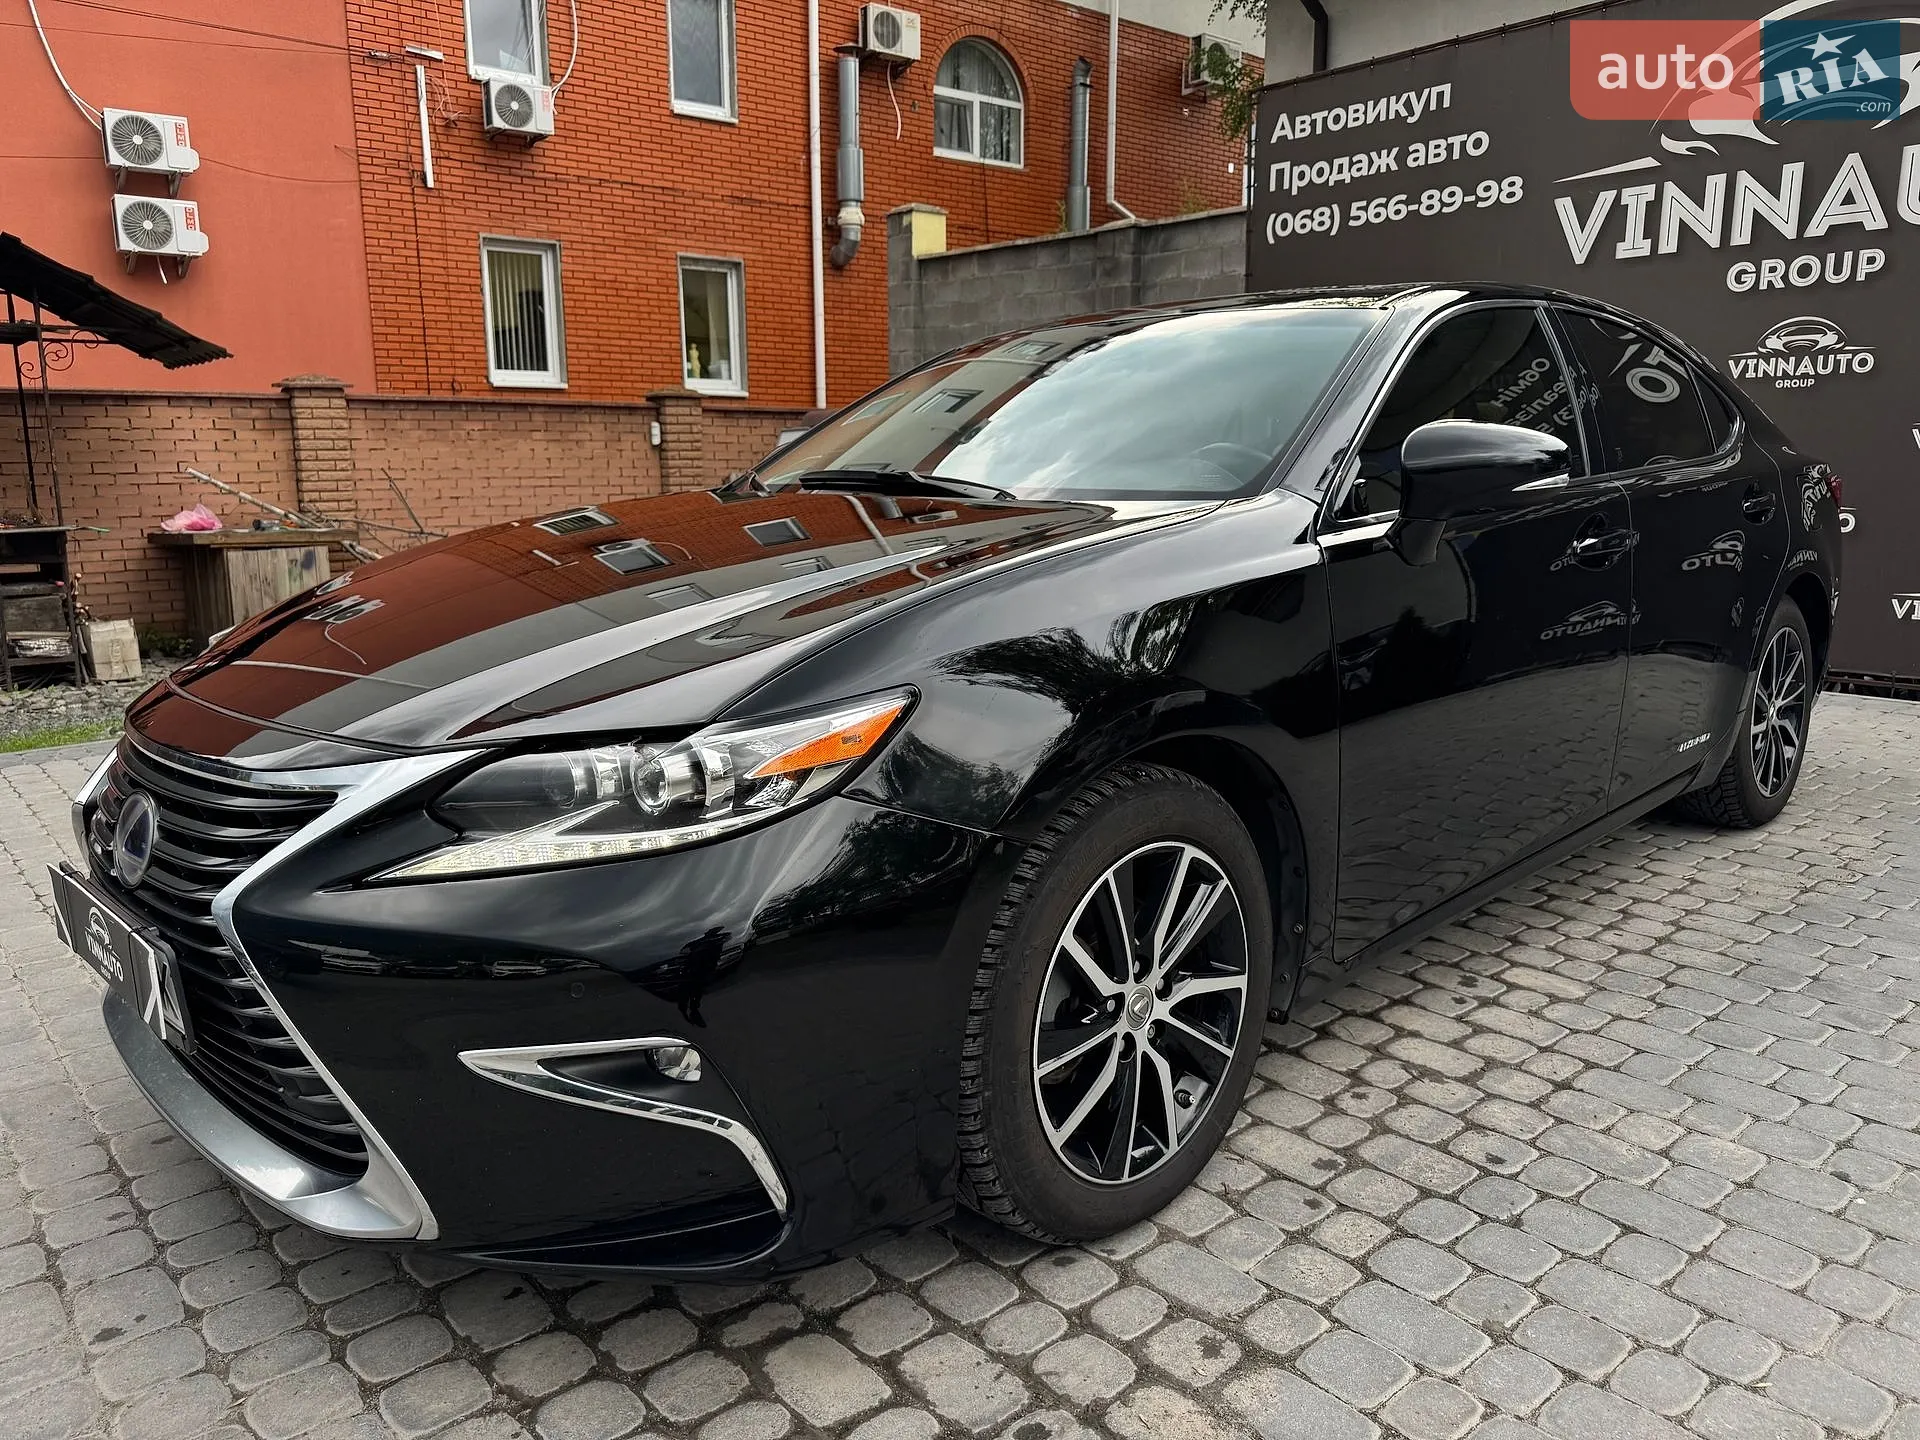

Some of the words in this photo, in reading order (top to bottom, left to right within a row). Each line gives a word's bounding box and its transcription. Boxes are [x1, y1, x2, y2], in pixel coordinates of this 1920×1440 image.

[1270, 83, 1452, 143] Автовикуп
[1269, 146, 1400, 195] Продаж
[1406, 131, 1490, 168] авто
[1266, 203, 1341, 245] (068)
[1348, 175, 1524, 226] 566-89-98
[1726, 248, 1886, 292] GROUP
[1728, 352, 1875, 380] VINNAUTO
[1775, 378, 1815, 389] GROUP
